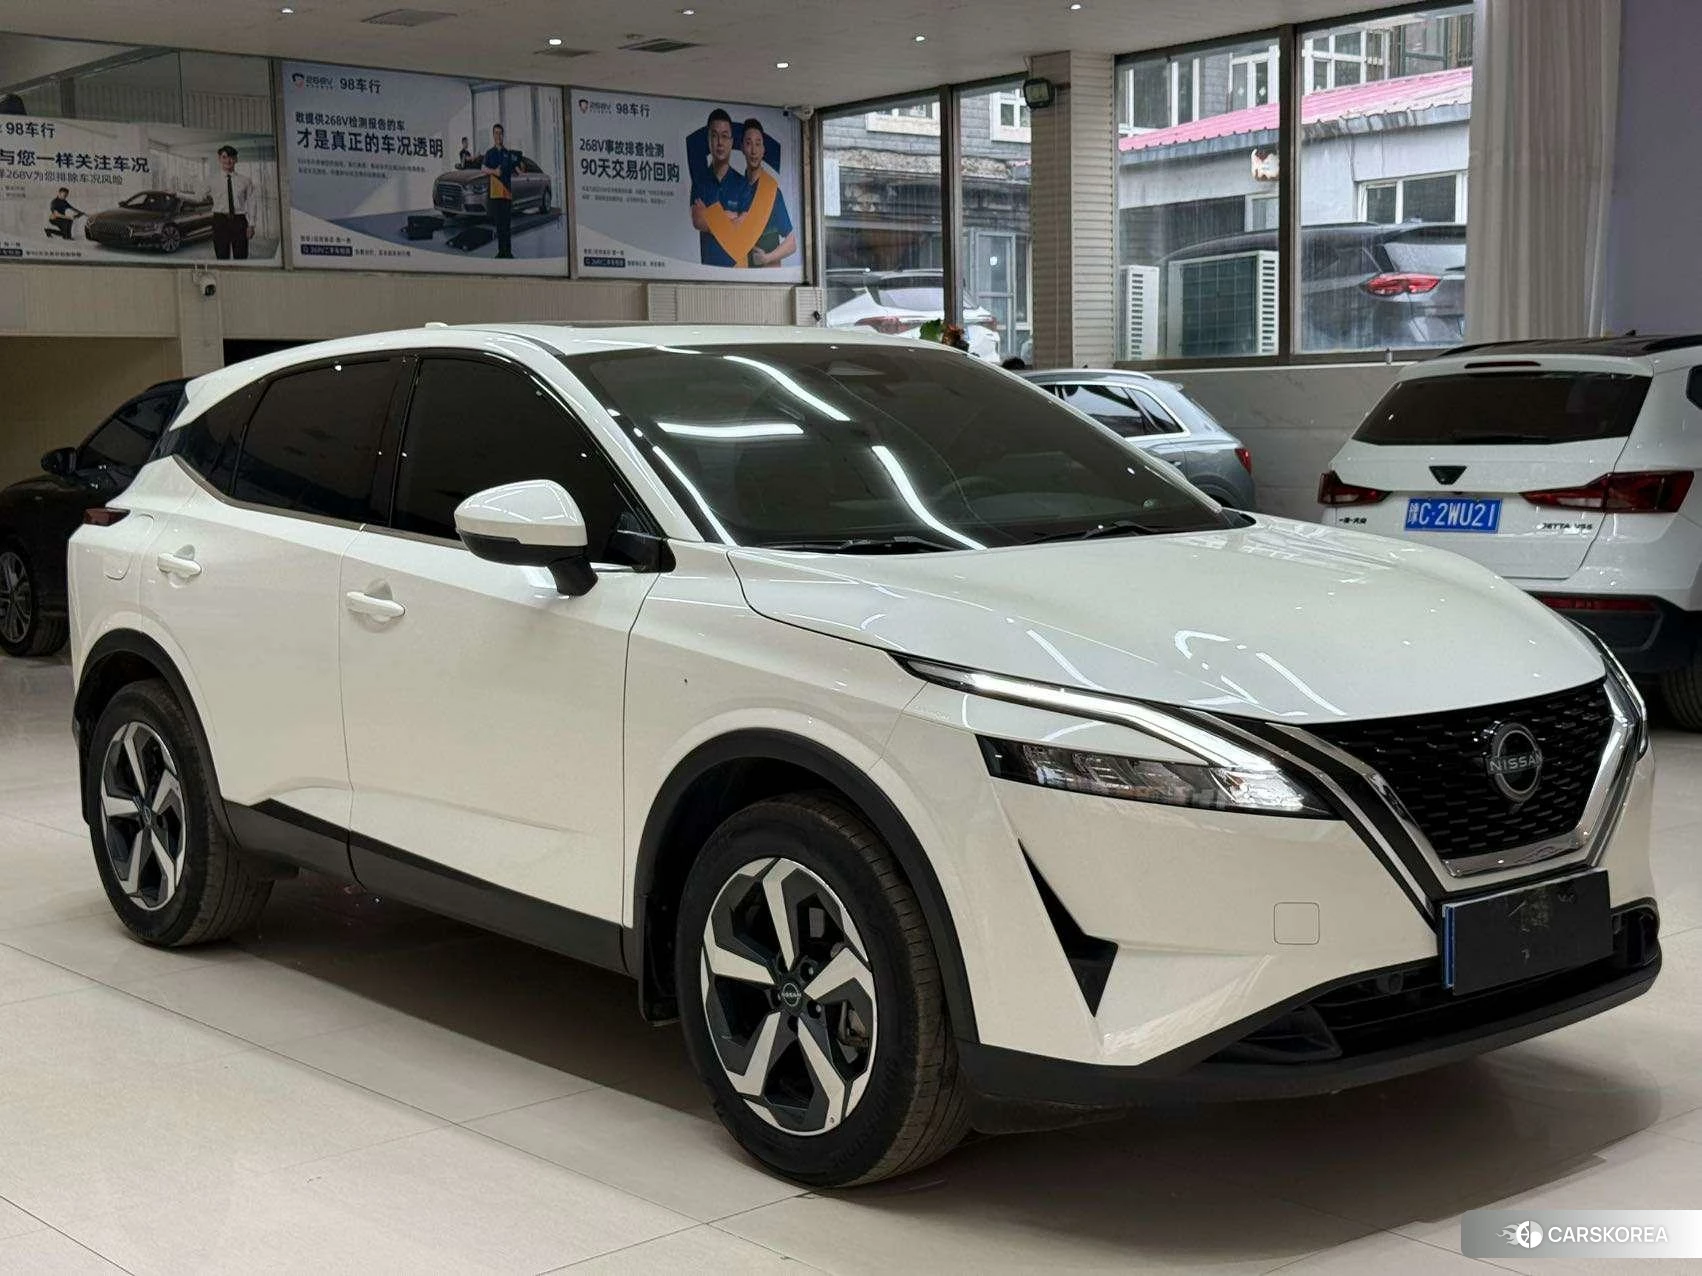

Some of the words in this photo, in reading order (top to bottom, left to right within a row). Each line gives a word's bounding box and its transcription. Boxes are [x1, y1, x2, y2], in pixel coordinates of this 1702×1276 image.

[340, 77, 382, 94] 98车行
[615, 102, 650, 118] 98车行
[5, 122, 55, 139] 98车行
[297, 130, 443, 159] 才是真正的车况透明
[579, 138, 665, 158] 268V事故排查检测
[0, 148, 150, 173] 与您一样关注车况
[581, 157, 680, 183] 90天交易价回购
